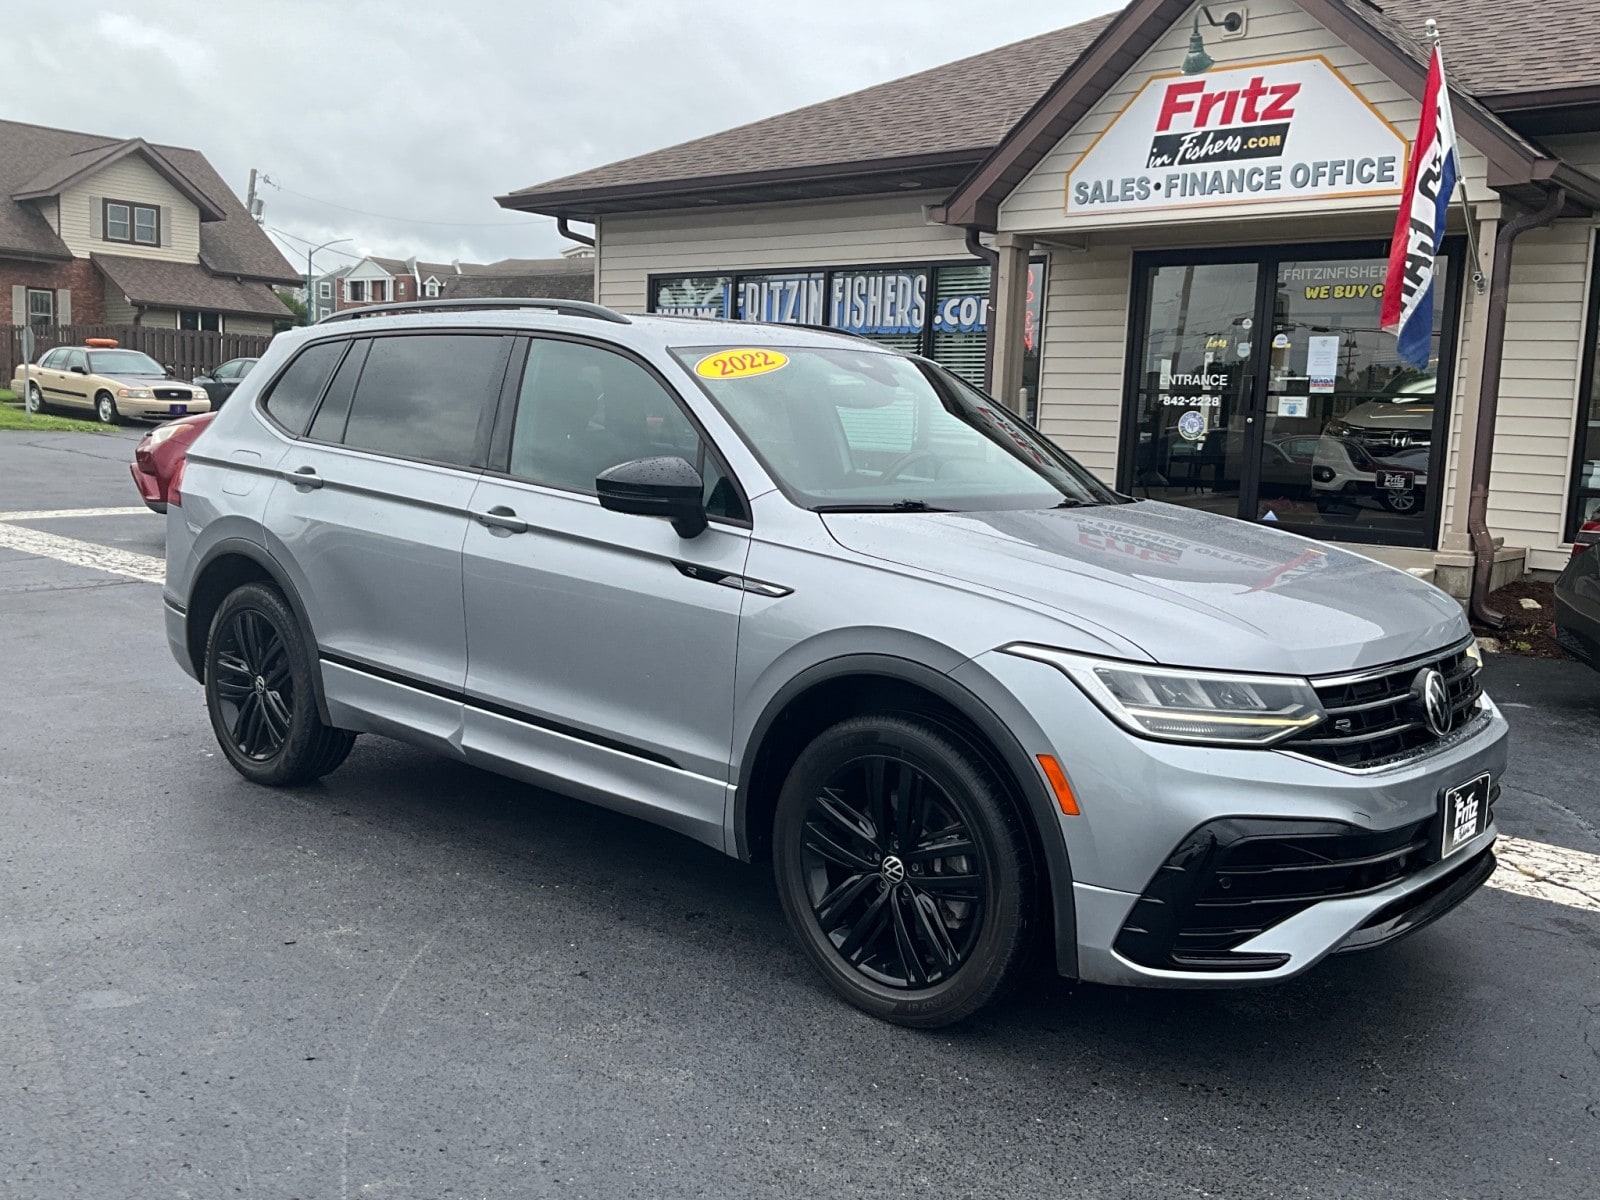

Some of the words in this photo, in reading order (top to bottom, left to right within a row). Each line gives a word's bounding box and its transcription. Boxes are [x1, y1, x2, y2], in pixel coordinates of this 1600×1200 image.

[1156, 76, 1302, 132] Fritz
[1150, 147, 1173, 167] in
[1289, 155, 1397, 188] OFFICE
[831, 274, 928, 328] FISHERS
[1305, 285, 1331, 300] WE
[1333, 283, 1369, 299] BUY
[713, 351, 776, 376] 2022
[1160, 373, 1229, 386] ENTRANCE
[1163, 395, 1220, 407] 842-2228
[1454, 797, 1479, 828] Fritz
